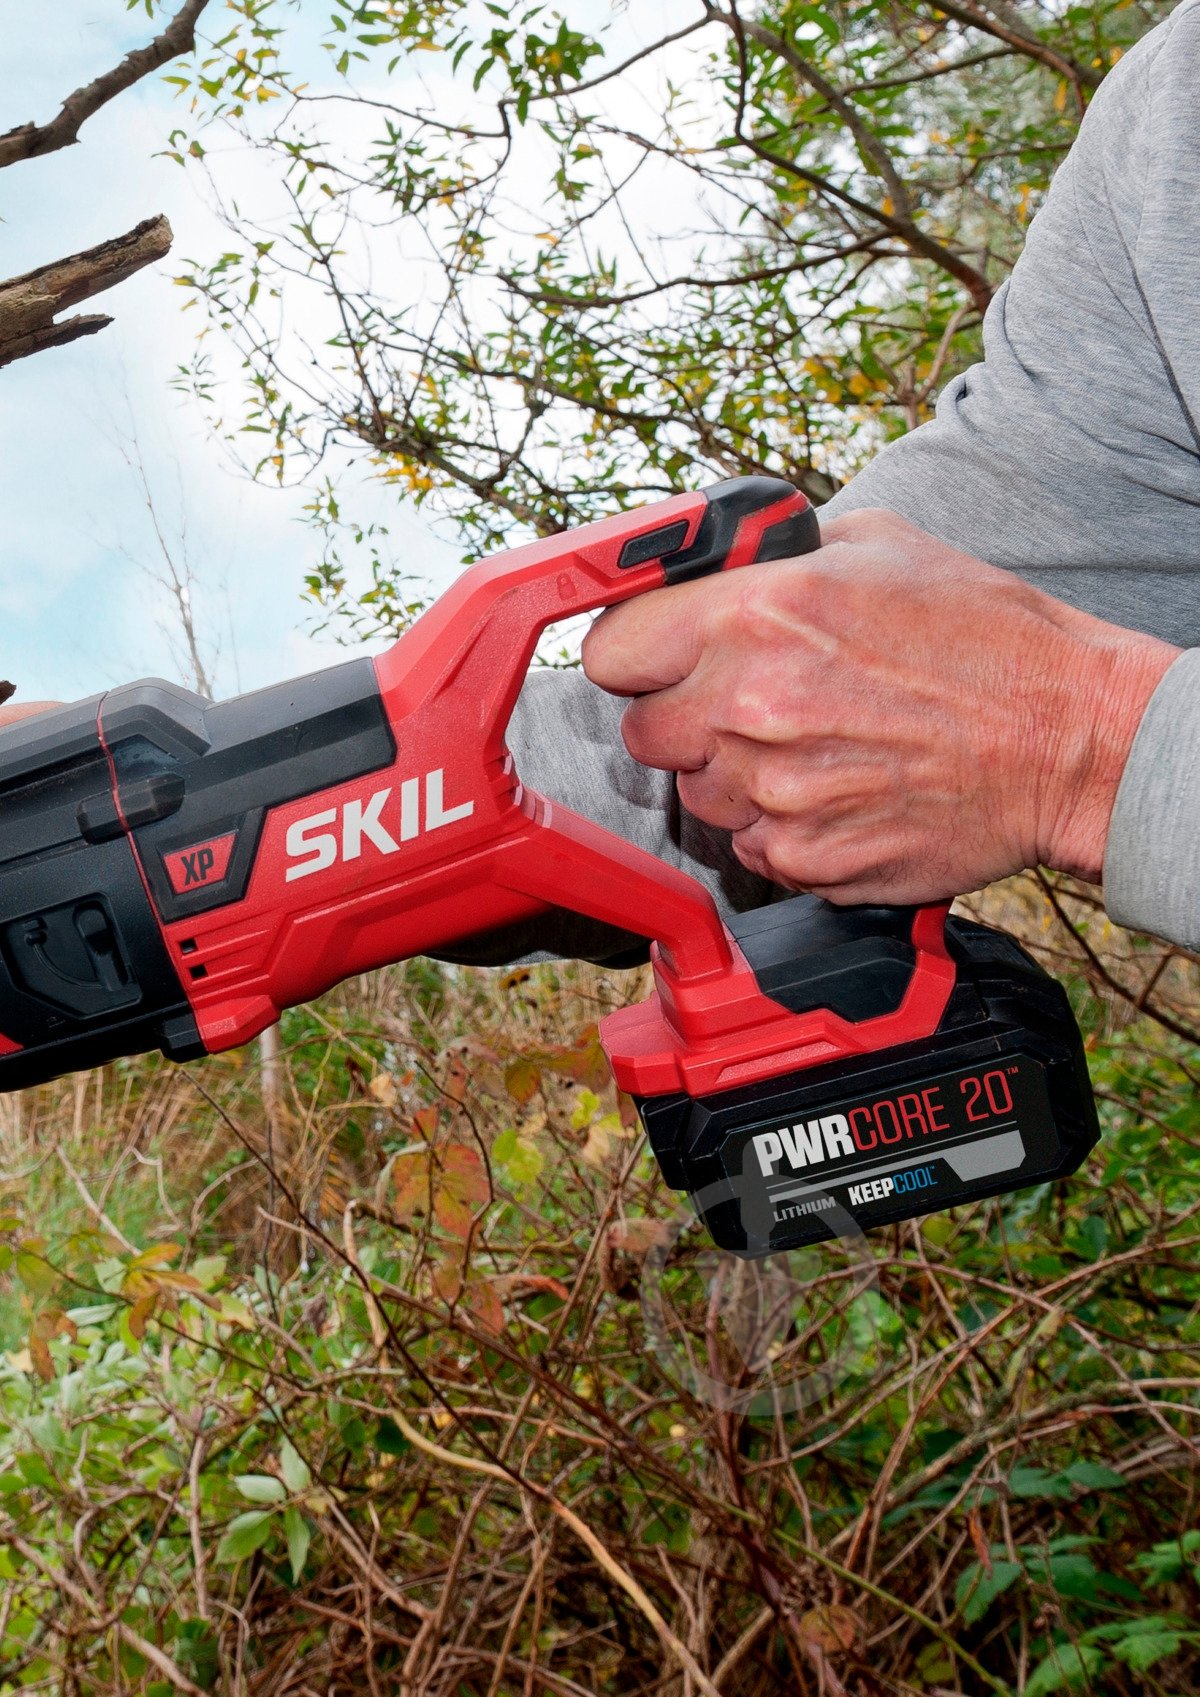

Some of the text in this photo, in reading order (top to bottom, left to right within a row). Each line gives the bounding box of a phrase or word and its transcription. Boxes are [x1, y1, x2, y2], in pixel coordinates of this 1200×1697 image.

[285, 768, 475, 883] SKIL
[180, 848, 215, 886] XP
[751, 1086, 950, 1177] PWRCORE
[773, 1196, 837, 1222] LITHIUM
